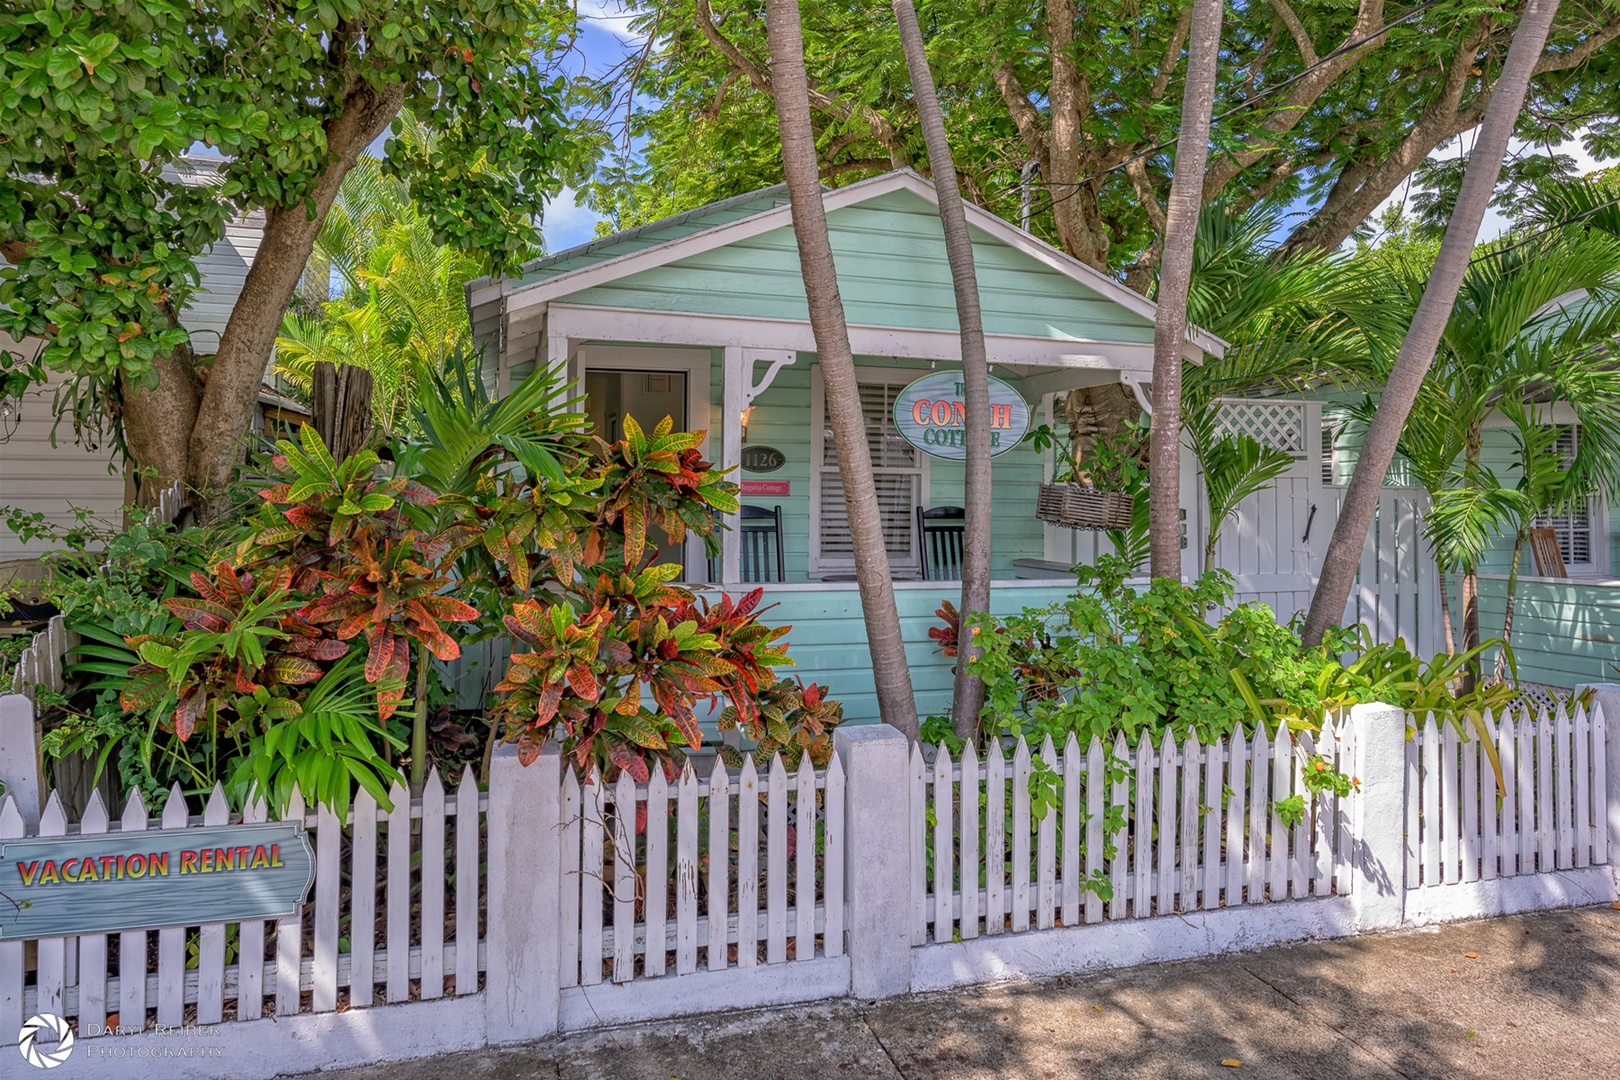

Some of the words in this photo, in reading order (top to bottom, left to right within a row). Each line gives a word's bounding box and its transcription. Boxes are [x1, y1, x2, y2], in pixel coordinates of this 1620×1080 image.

[912, 399, 1012, 429] CONH
[923, 427, 1000, 448] COTTE
[745, 452, 777, 467] 1126
[762, 483, 782, 493] Cottage
[17, 852, 169, 886] VACATION
[180, 843, 284, 875] RENTAL
